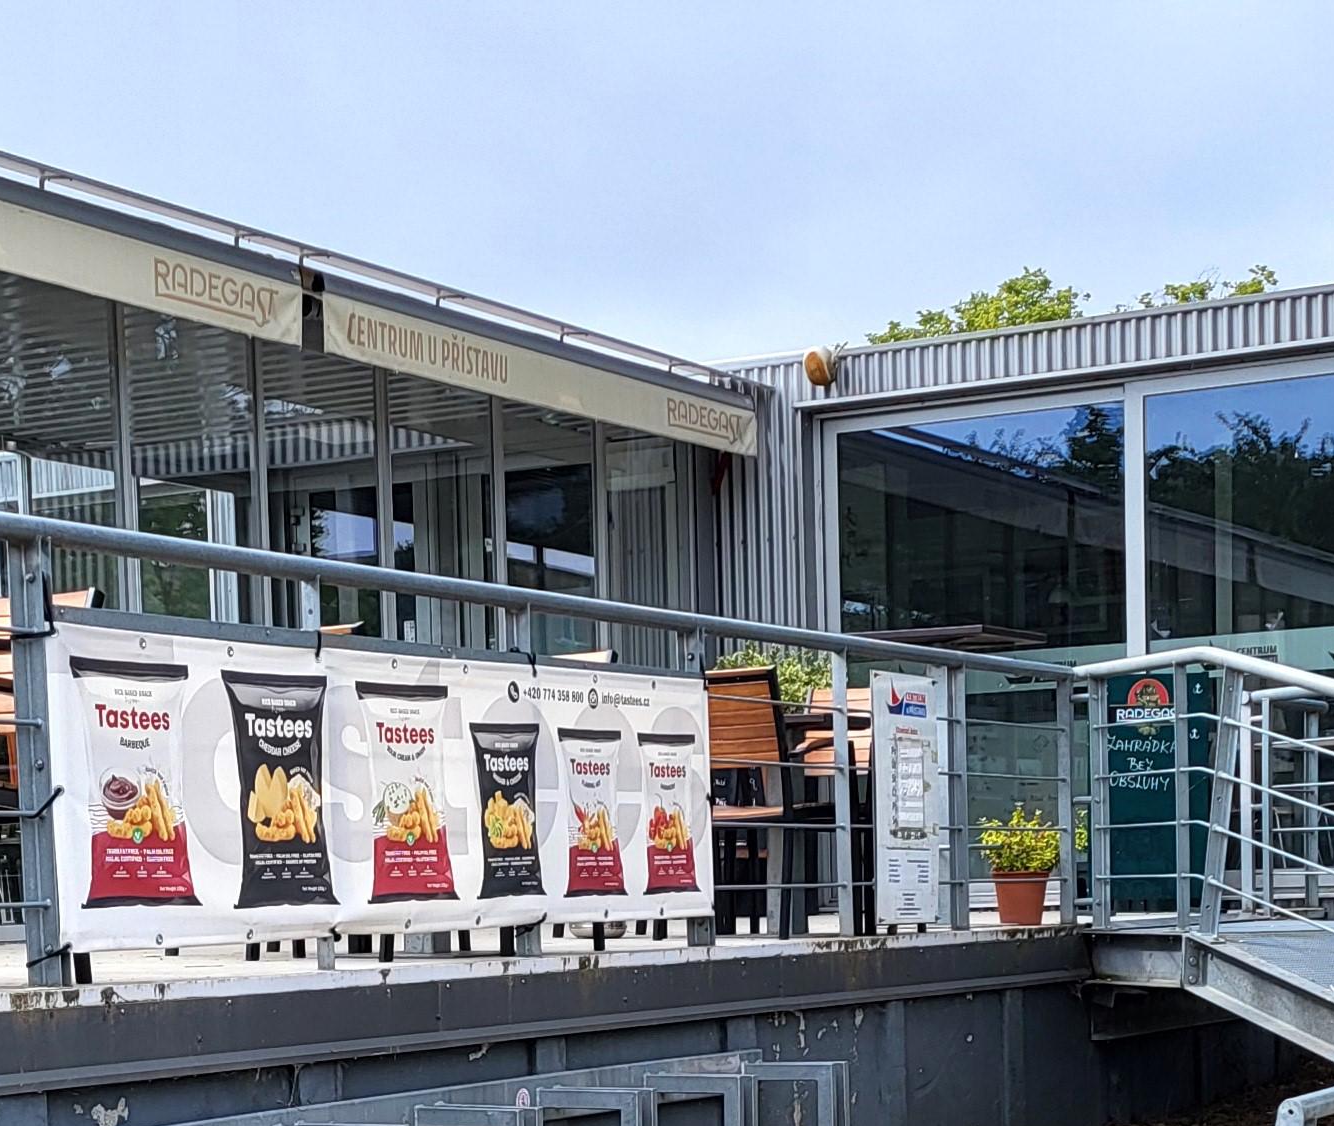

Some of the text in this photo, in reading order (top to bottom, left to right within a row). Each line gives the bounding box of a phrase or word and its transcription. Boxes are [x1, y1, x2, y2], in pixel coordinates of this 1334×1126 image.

[154, 256, 279, 328] RADEGAST
[346, 311, 509, 384] CENTRUM U PŘÍSTAVU
[667, 396, 742, 445] RADEGAST
[94, 703, 171, 731] Tastees
[244, 713, 313, 739] Tastees
[1116, 708, 1176, 723] RADEGAS
[375, 721, 435, 745] Tastees
[483, 753, 530, 772] Tastees
[569, 758, 611, 776] Tastees
[649, 762, 687, 778] Tastees
